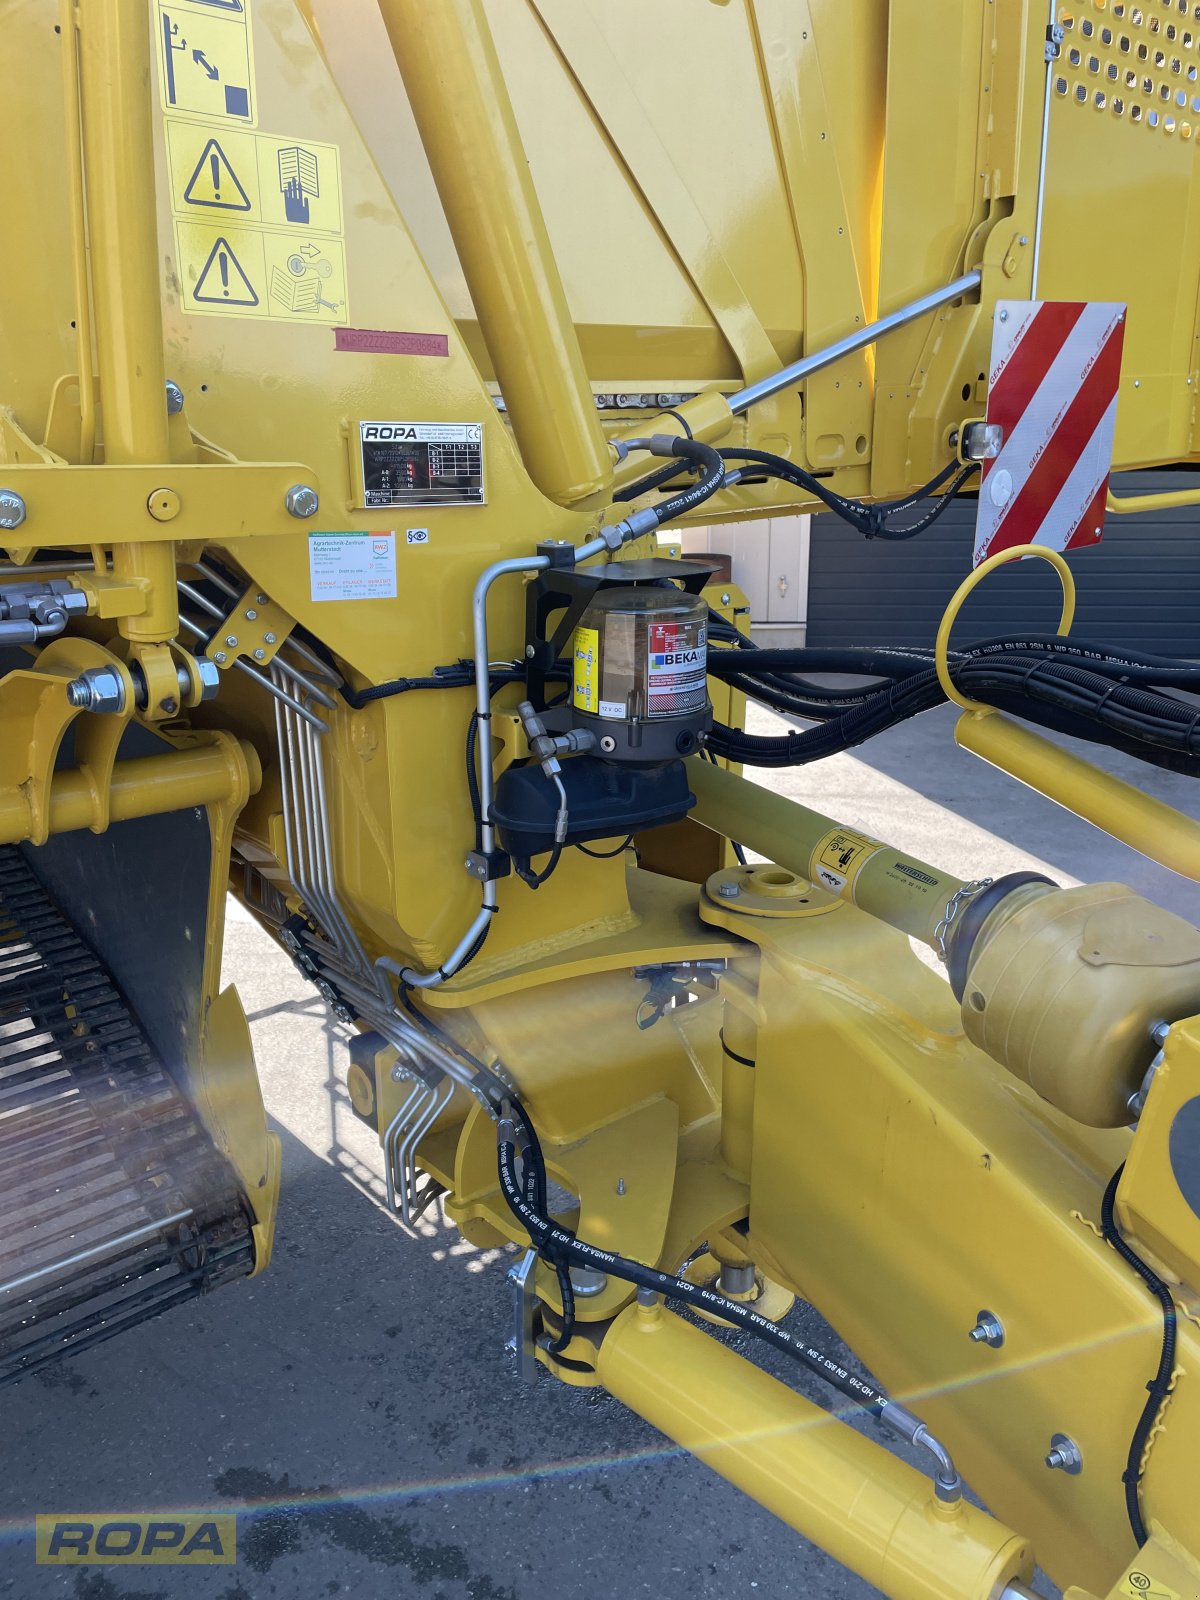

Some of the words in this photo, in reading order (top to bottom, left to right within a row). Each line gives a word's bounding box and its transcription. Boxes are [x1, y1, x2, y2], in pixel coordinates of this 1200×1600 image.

[989, 359, 1006, 386] GEKA
[1080, 356, 1095, 380] GEKA
[365, 427, 417, 440] ROPA
[1028, 445, 1044, 470] GEKA
[1063, 517, 1078, 543] GEKA
[559, 1233, 570, 1243] HD
[571, 1239, 616, 1263] HANSA-FLEX
[676, 1280, 695, 1292] 4Q21
[701, 1290, 725, 1305] IC-8/19
[726, 1301, 748, 1316] MSHA
[751, 1313, 767, 1324] BAR
[766, 1322, 780, 1334] 330
[778, 1329, 791, 1341] WP
[807, 1348, 819, 1359] SN
[823, 1359, 837, 1372] 853
[835, 1367, 848, 1379] EN
[849, 1377, 862, 1389] 210
[860, 1385, 874, 1397] HD
[1133, 1576, 1147, 1587] 40
